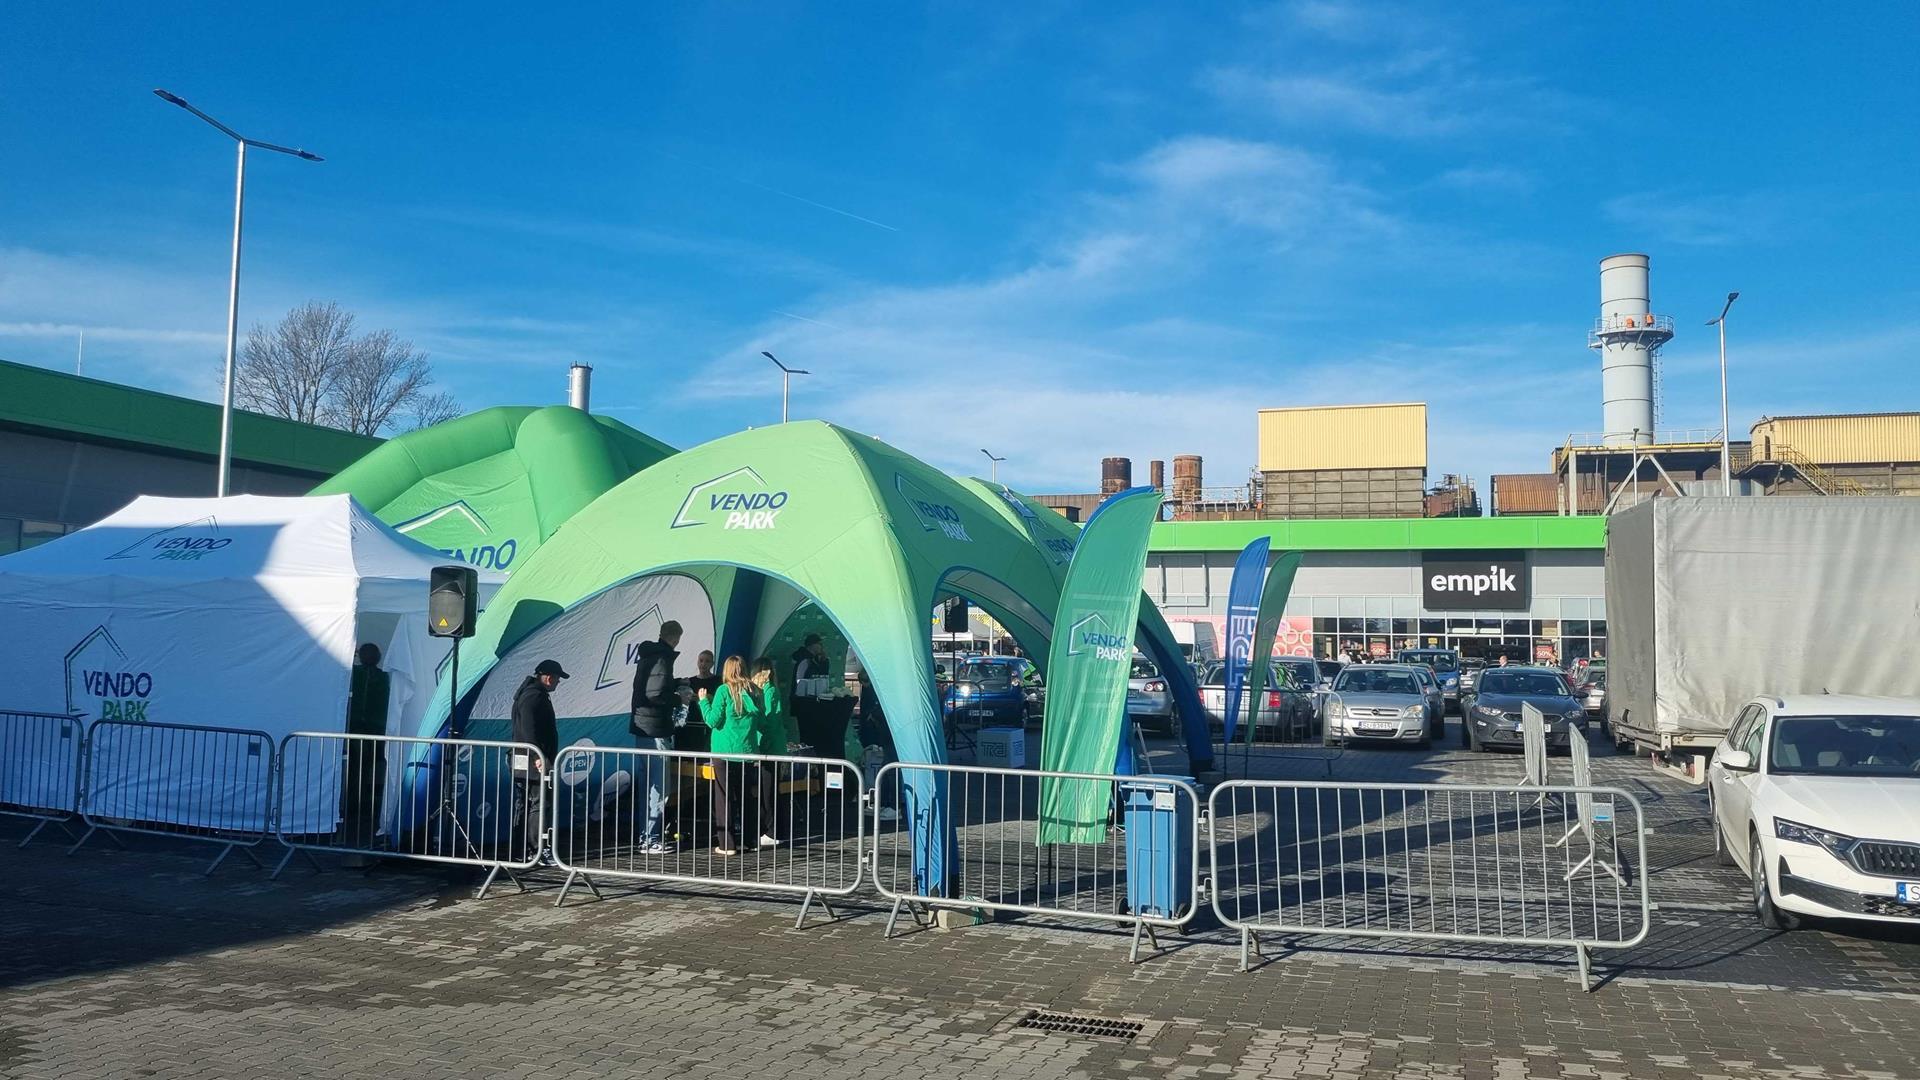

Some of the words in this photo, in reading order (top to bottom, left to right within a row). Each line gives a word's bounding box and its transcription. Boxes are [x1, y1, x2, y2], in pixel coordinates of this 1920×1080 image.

[711, 491, 788, 511] VENDO
[911, 498, 960, 522] VENDO
[724, 510, 782, 530] PARK
[938, 520, 974, 542] PARK
[152, 537, 233, 550] VENDO
[151, 549, 215, 561] PARK
[1430, 565, 1517, 596] empik
[1082, 632, 1127, 648] VENDO
[1096, 646, 1127, 661] PARK
[83, 670, 152, 698] VENDO
[102, 699, 151, 721] PARK
